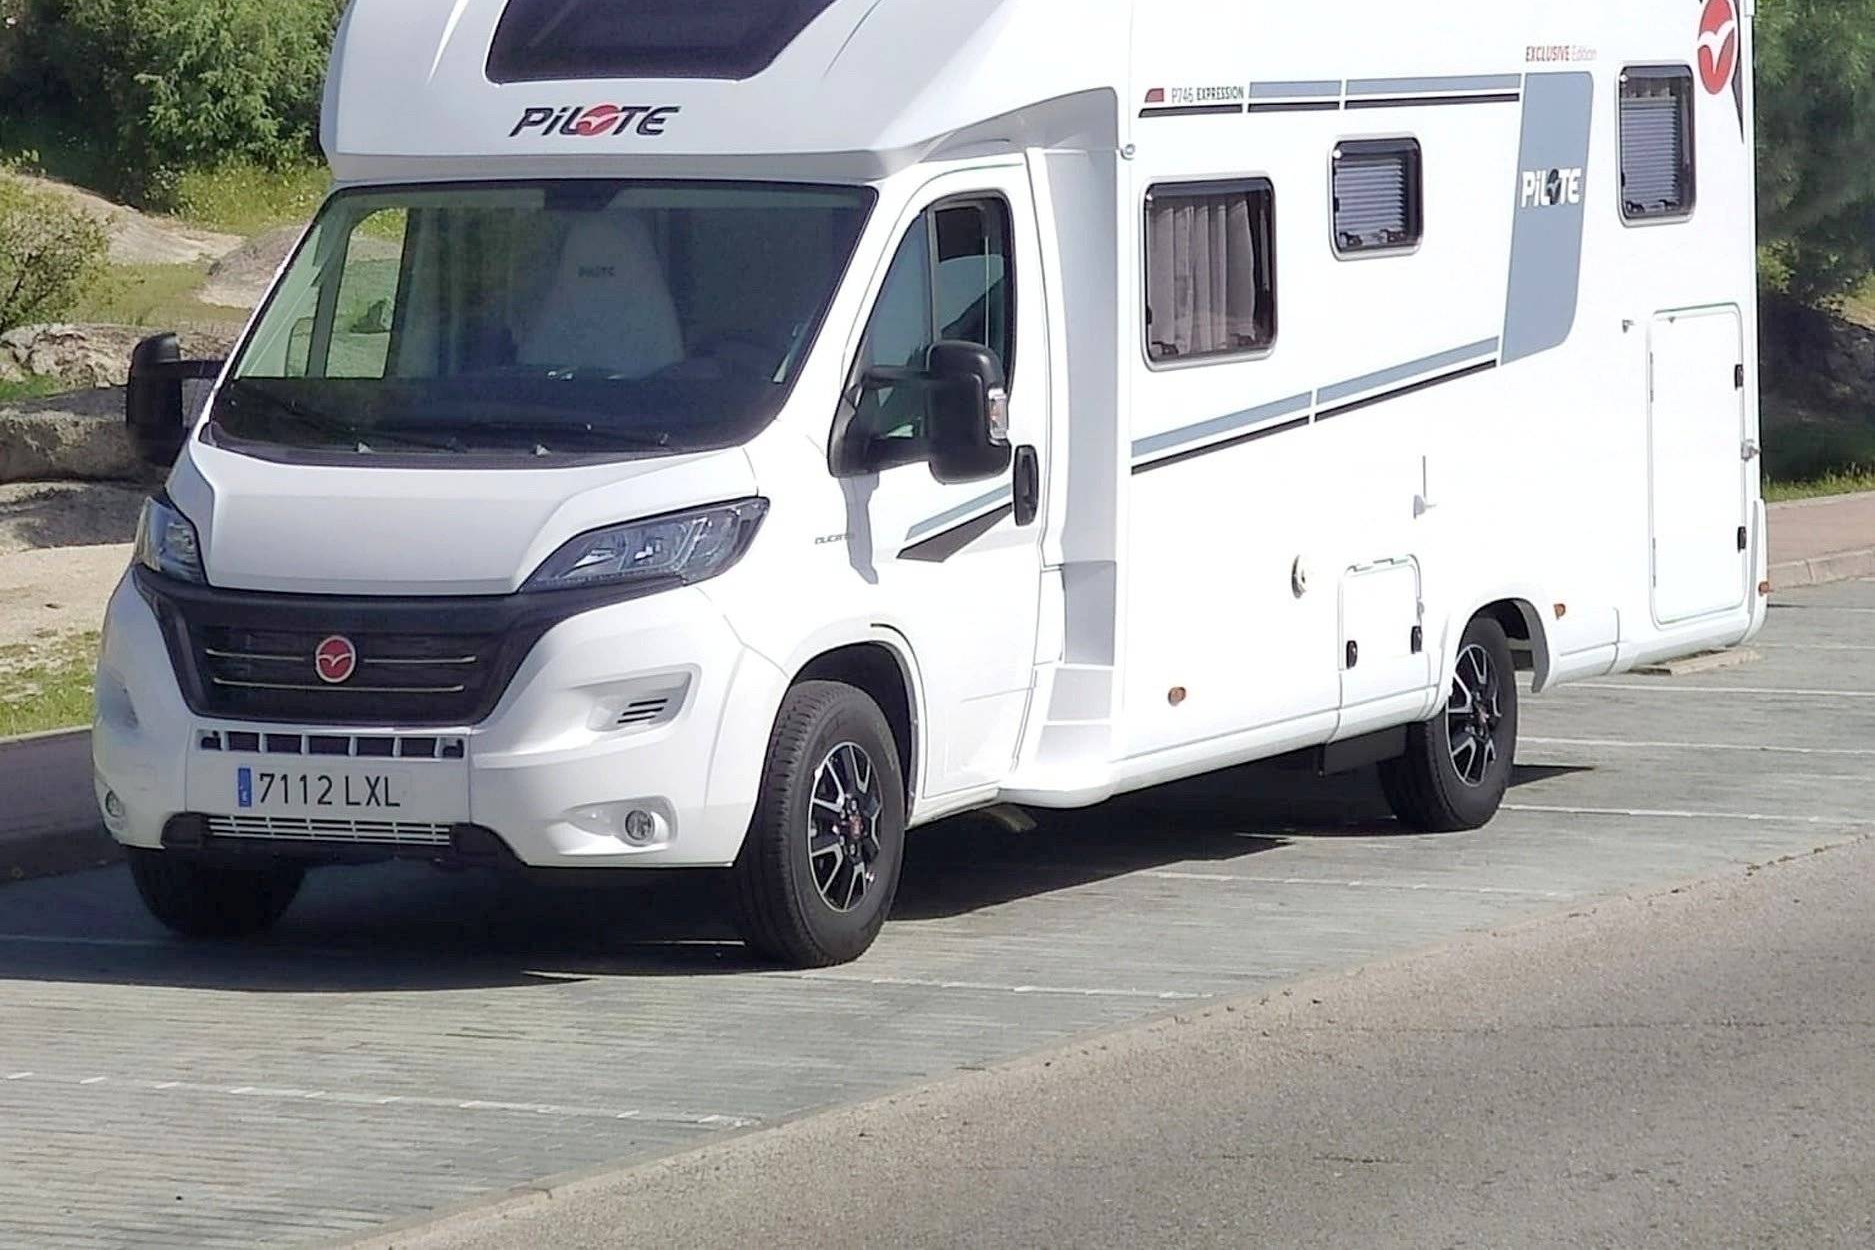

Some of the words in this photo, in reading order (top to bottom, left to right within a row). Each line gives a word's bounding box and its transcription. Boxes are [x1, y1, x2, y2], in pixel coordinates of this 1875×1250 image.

[1525, 46, 1569, 61] EXCLUSIVE
[1196, 86, 1244, 101] EXPRESSION
[259, 773, 333, 805] 7112
[345, 775, 401, 807] LXL
